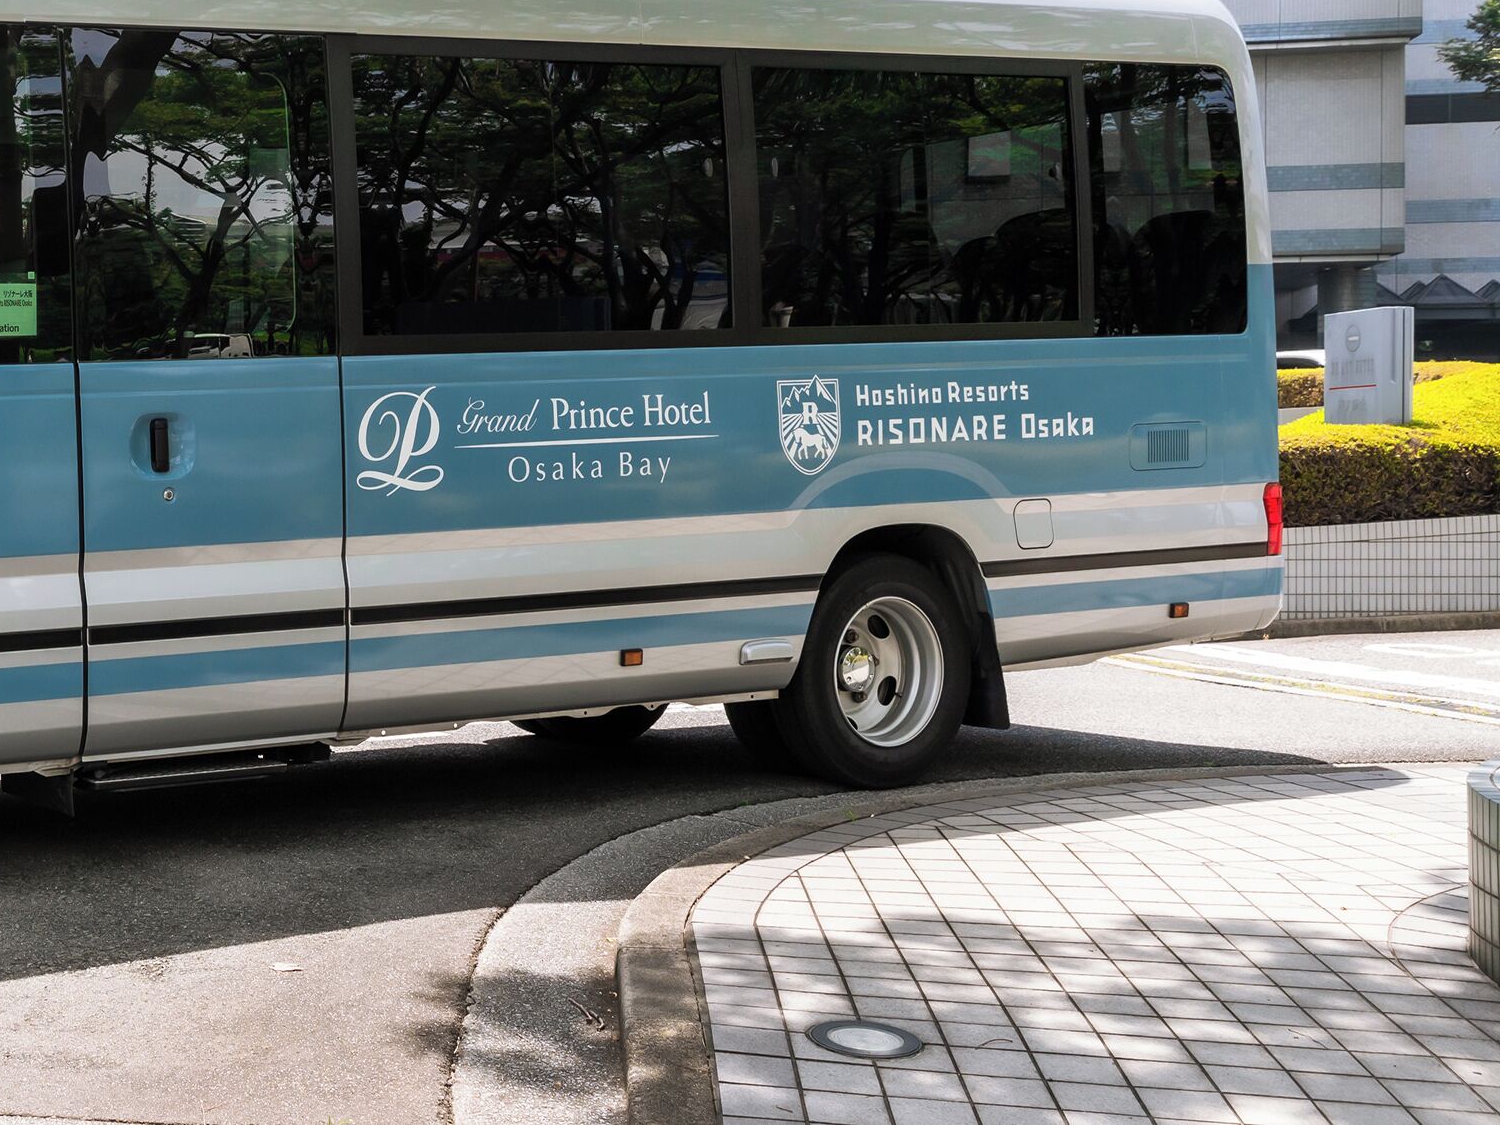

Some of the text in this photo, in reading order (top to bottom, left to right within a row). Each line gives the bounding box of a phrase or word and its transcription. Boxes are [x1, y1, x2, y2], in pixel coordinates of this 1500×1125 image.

[856, 380, 1029, 407] Hoshino Resorts
[456, 390, 712, 435] Grand Prince Hotel
[857, 411, 1094, 447] RISONARE Osaka
[508, 451, 671, 484] Osaka Bay
